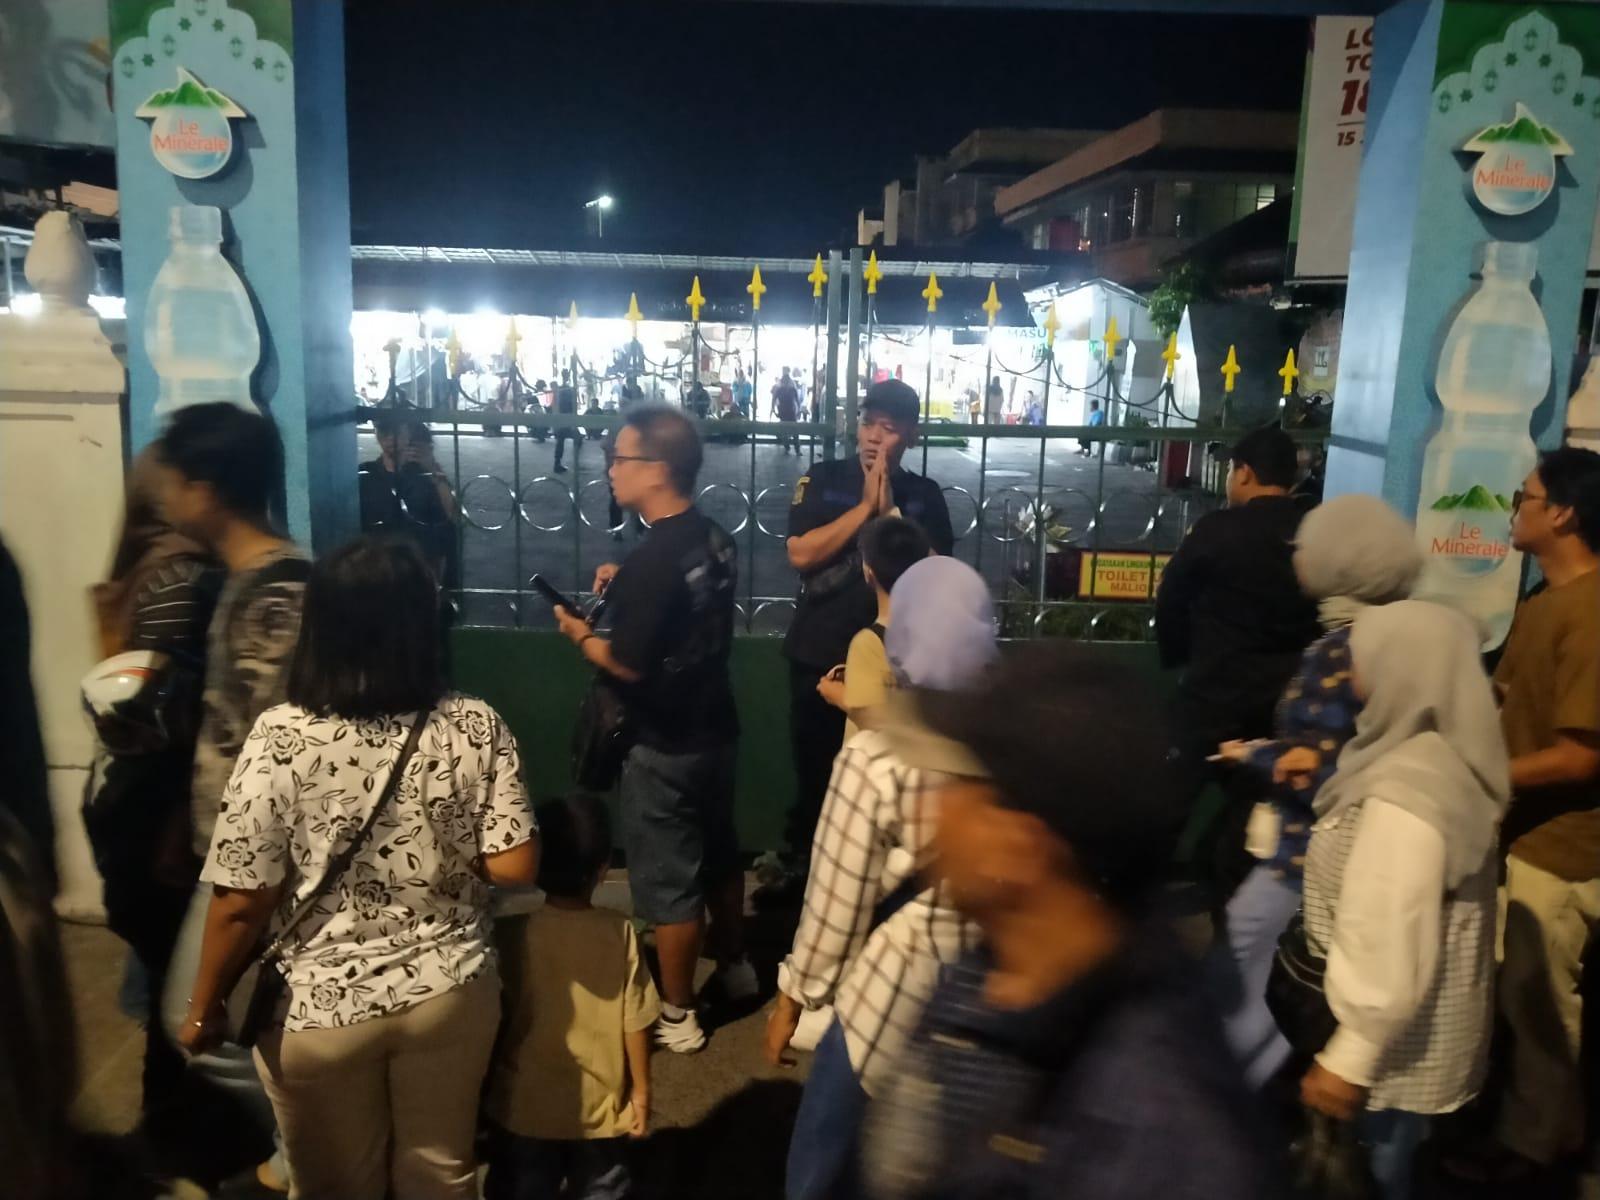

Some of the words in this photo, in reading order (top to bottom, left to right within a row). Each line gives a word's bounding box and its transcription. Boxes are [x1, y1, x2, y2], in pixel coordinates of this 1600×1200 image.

[179, 117, 198, 135] Le
[154, 134, 228, 152] Minerale
[1337, 131, 1356, 147] 15
[1505, 153, 1524, 172] Le
[1478, 169, 1550, 190] Minerale
[1460, 522, 1481, 539] Le
[1432, 537, 1507, 557] Minerale
[1097, 570, 1148, 581] TOILET
